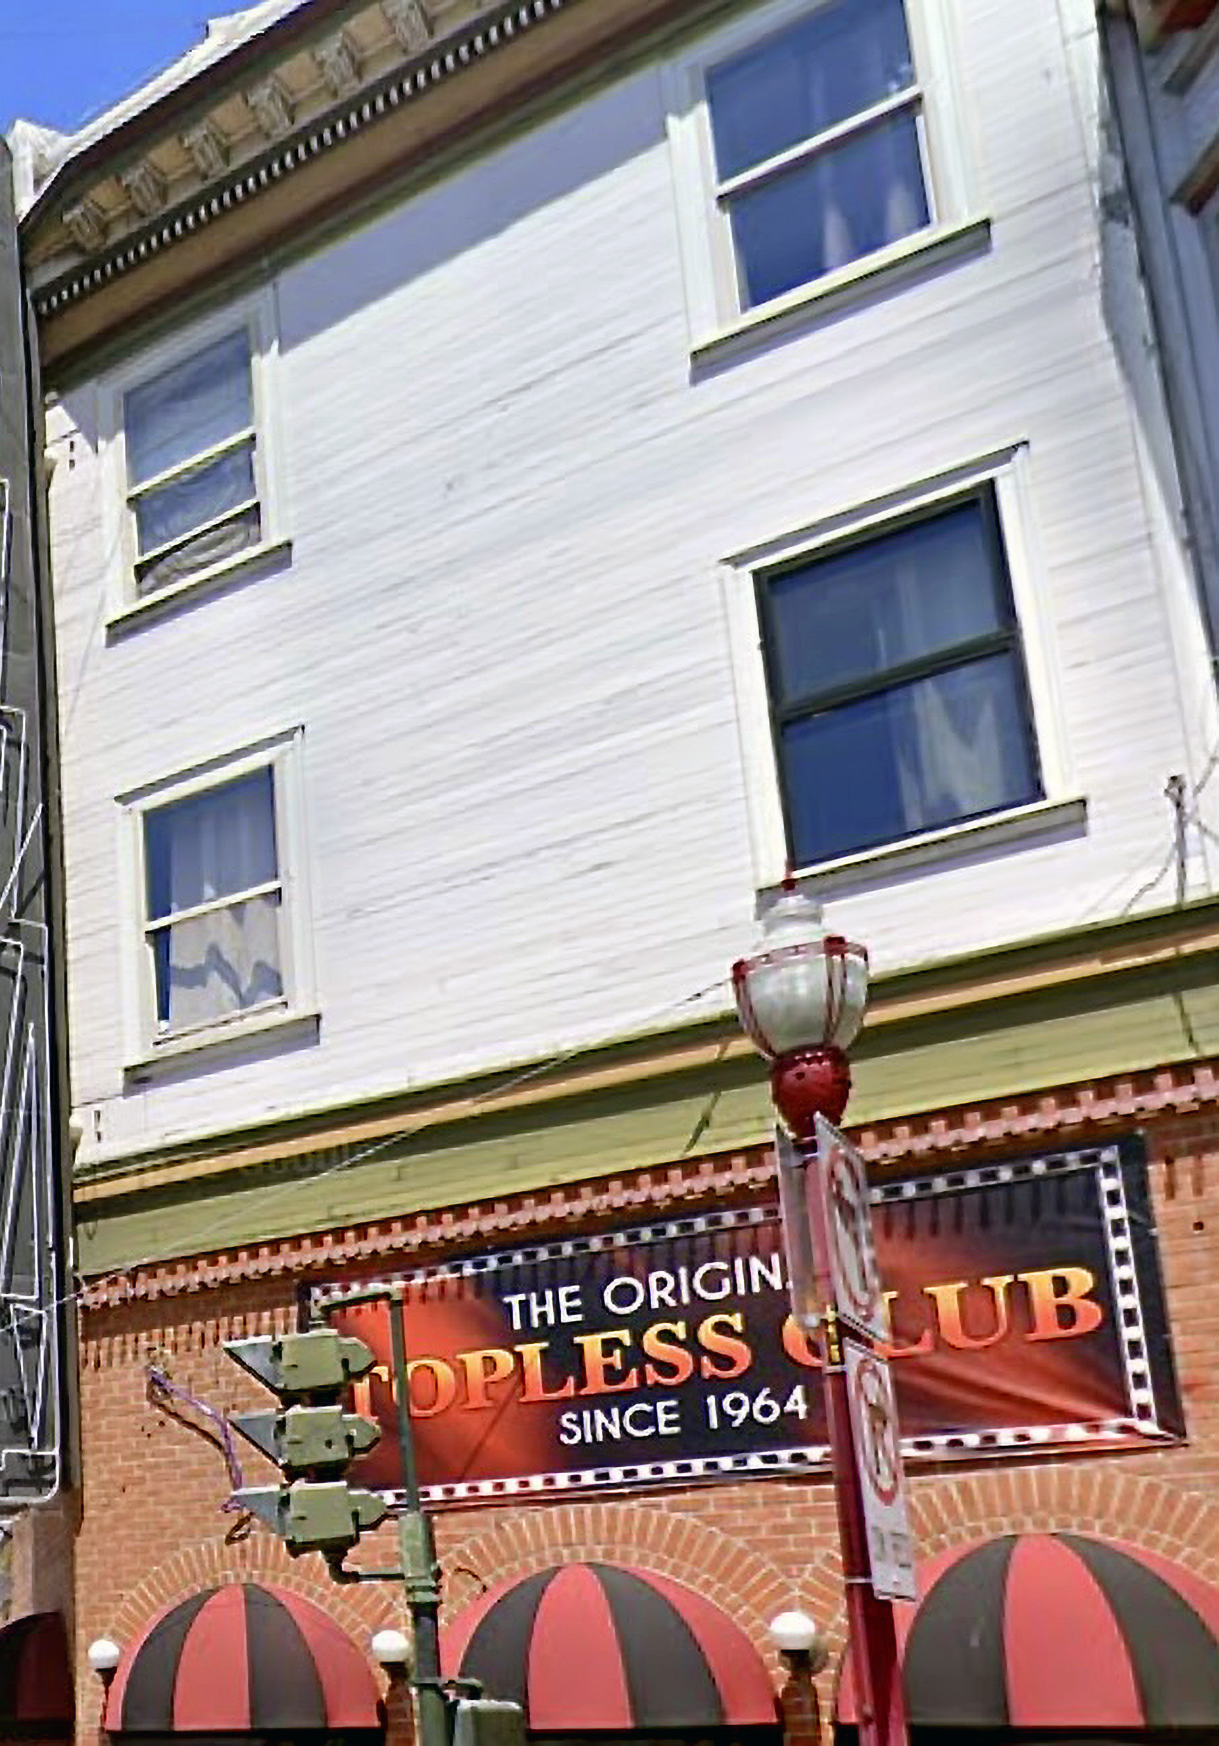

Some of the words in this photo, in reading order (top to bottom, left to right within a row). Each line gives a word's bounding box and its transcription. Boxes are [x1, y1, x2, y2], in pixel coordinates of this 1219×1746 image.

[503, 1285, 584, 1331] THE
[603, 1252, 794, 1316] ORIGIN
[353, 1312, 753, 1420] TOPLESS
[558, 1399, 682, 1445] SINCE
[705, 1383, 809, 1431] 1964
